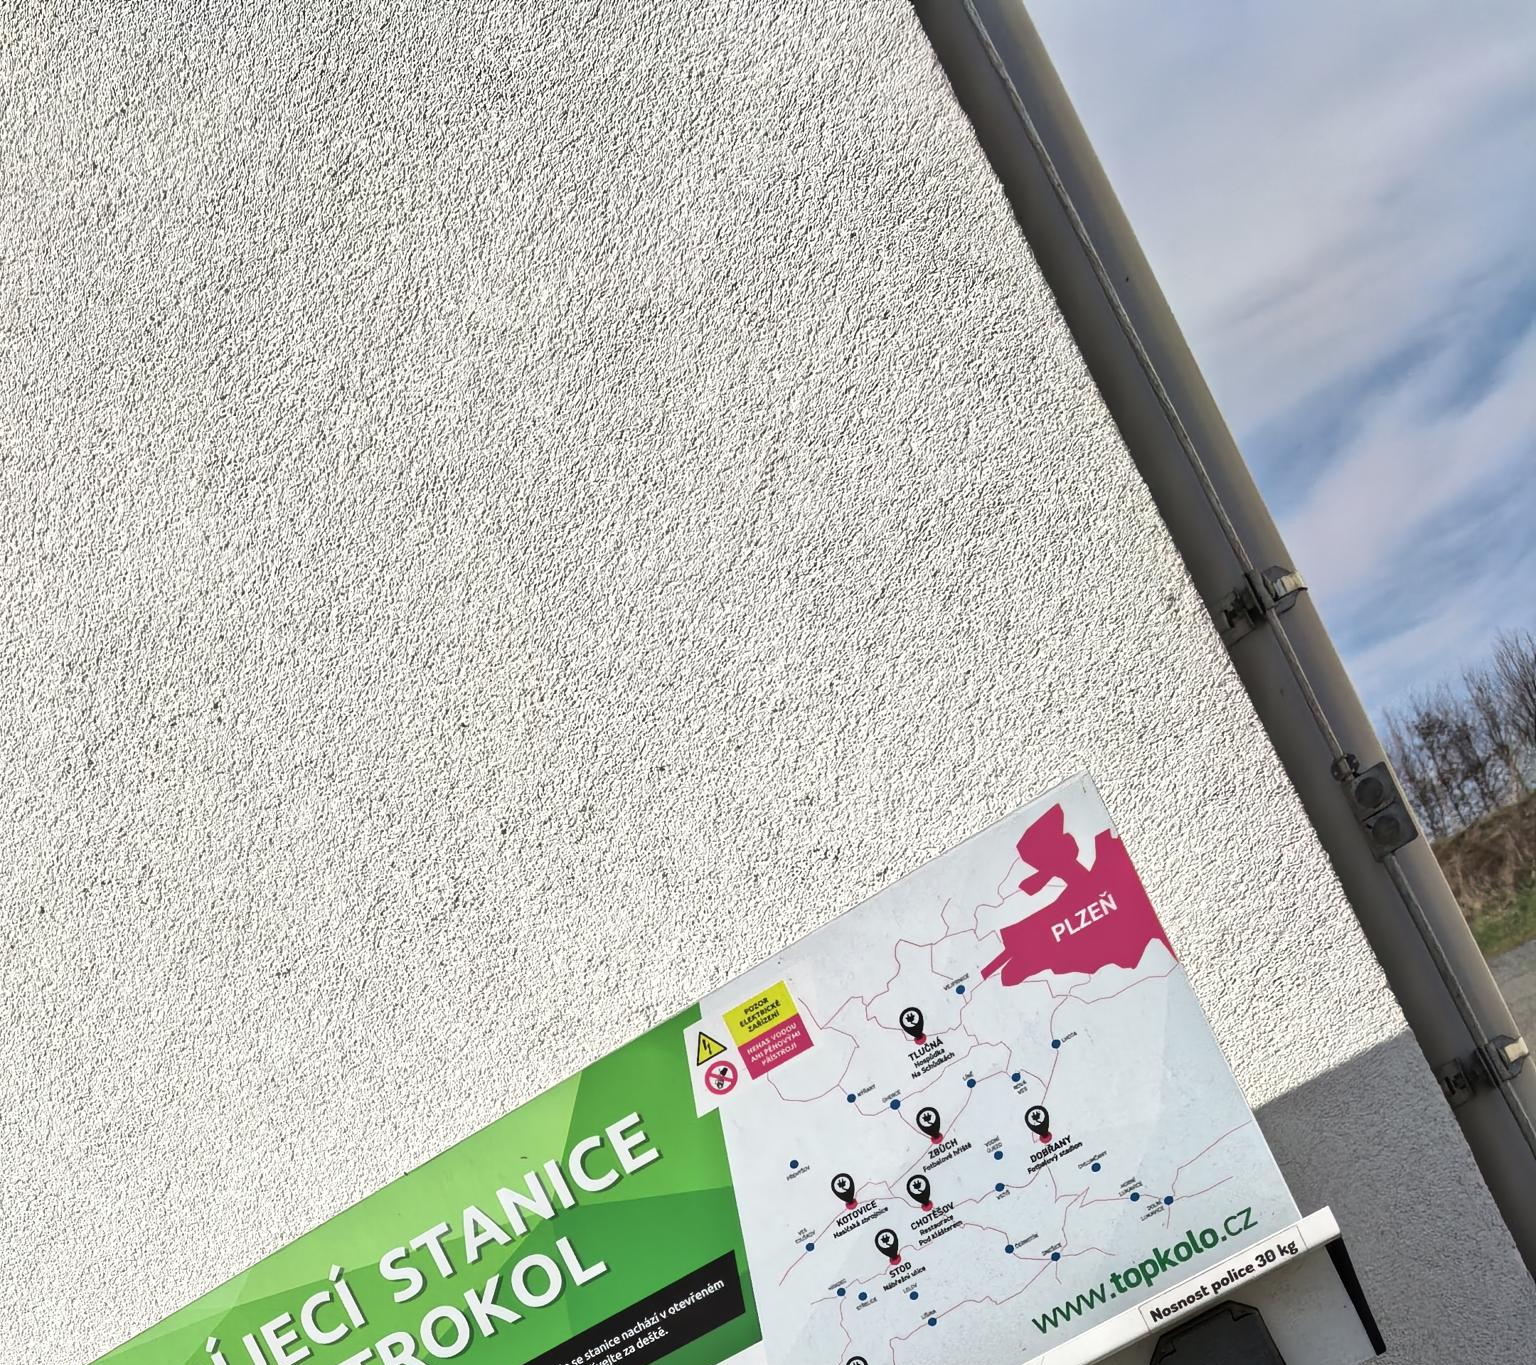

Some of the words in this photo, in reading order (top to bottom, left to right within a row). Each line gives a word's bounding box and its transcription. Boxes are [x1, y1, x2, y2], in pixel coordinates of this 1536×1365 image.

[1050, 890, 1117, 942] PLZEŇ
[739, 999, 780, 1027] ELEKTRICKÉ
[743, 996, 769, 1015] POZOR
[770, 1021, 796, 1040] VODOU
[907, 1035, 943, 1061] TLUČNÁ
[913, 1047, 945, 1068] Hospůdka
[911, 1070, 921, 1079] Na
[921, 1051, 955, 1074] Schůdkách
[922, 1151, 952, 1173] Fotbalové
[952, 1141, 972, 1156] hřiště
[927, 1137, 958, 1159] ZBŮCH
[1026, 1153, 1058, 1174] Fotbalový
[1058, 1141, 1083, 1157] stadion
[1029, 1134, 1071, 1163] DOBŘANY
[376, 1111, 661, 1304] STANICE
[835, 1199, 877, 1227] KOTOVICE
[910, 1201, 954, 1230] CHOTĚŠOV
[918, 1214, 954, 1236] Restaurace
[918, 1235, 931, 1246] Pod
[930, 1219, 963, 1239] Klášterem
[888, 1261, 911, 1278] STOD
[1030, 1206, 1258, 1334] www.topkolo.cz
[1149, 1284, 1210, 1322] Nosnost
[1210, 1263, 1255, 1295] police
[1254, 1248, 1276, 1267] 30
[1276, 1240, 1299, 1259] kg
[583, 1335, 621, 1361] stanice
[620, 1311, 660, 1340] nachází
[658, 1310, 666, 1319] v
[667, 1279, 724, 1315] otevřeném
[622, 1344, 636, 1356] za
[635, 1325, 669, 1349] deště.
